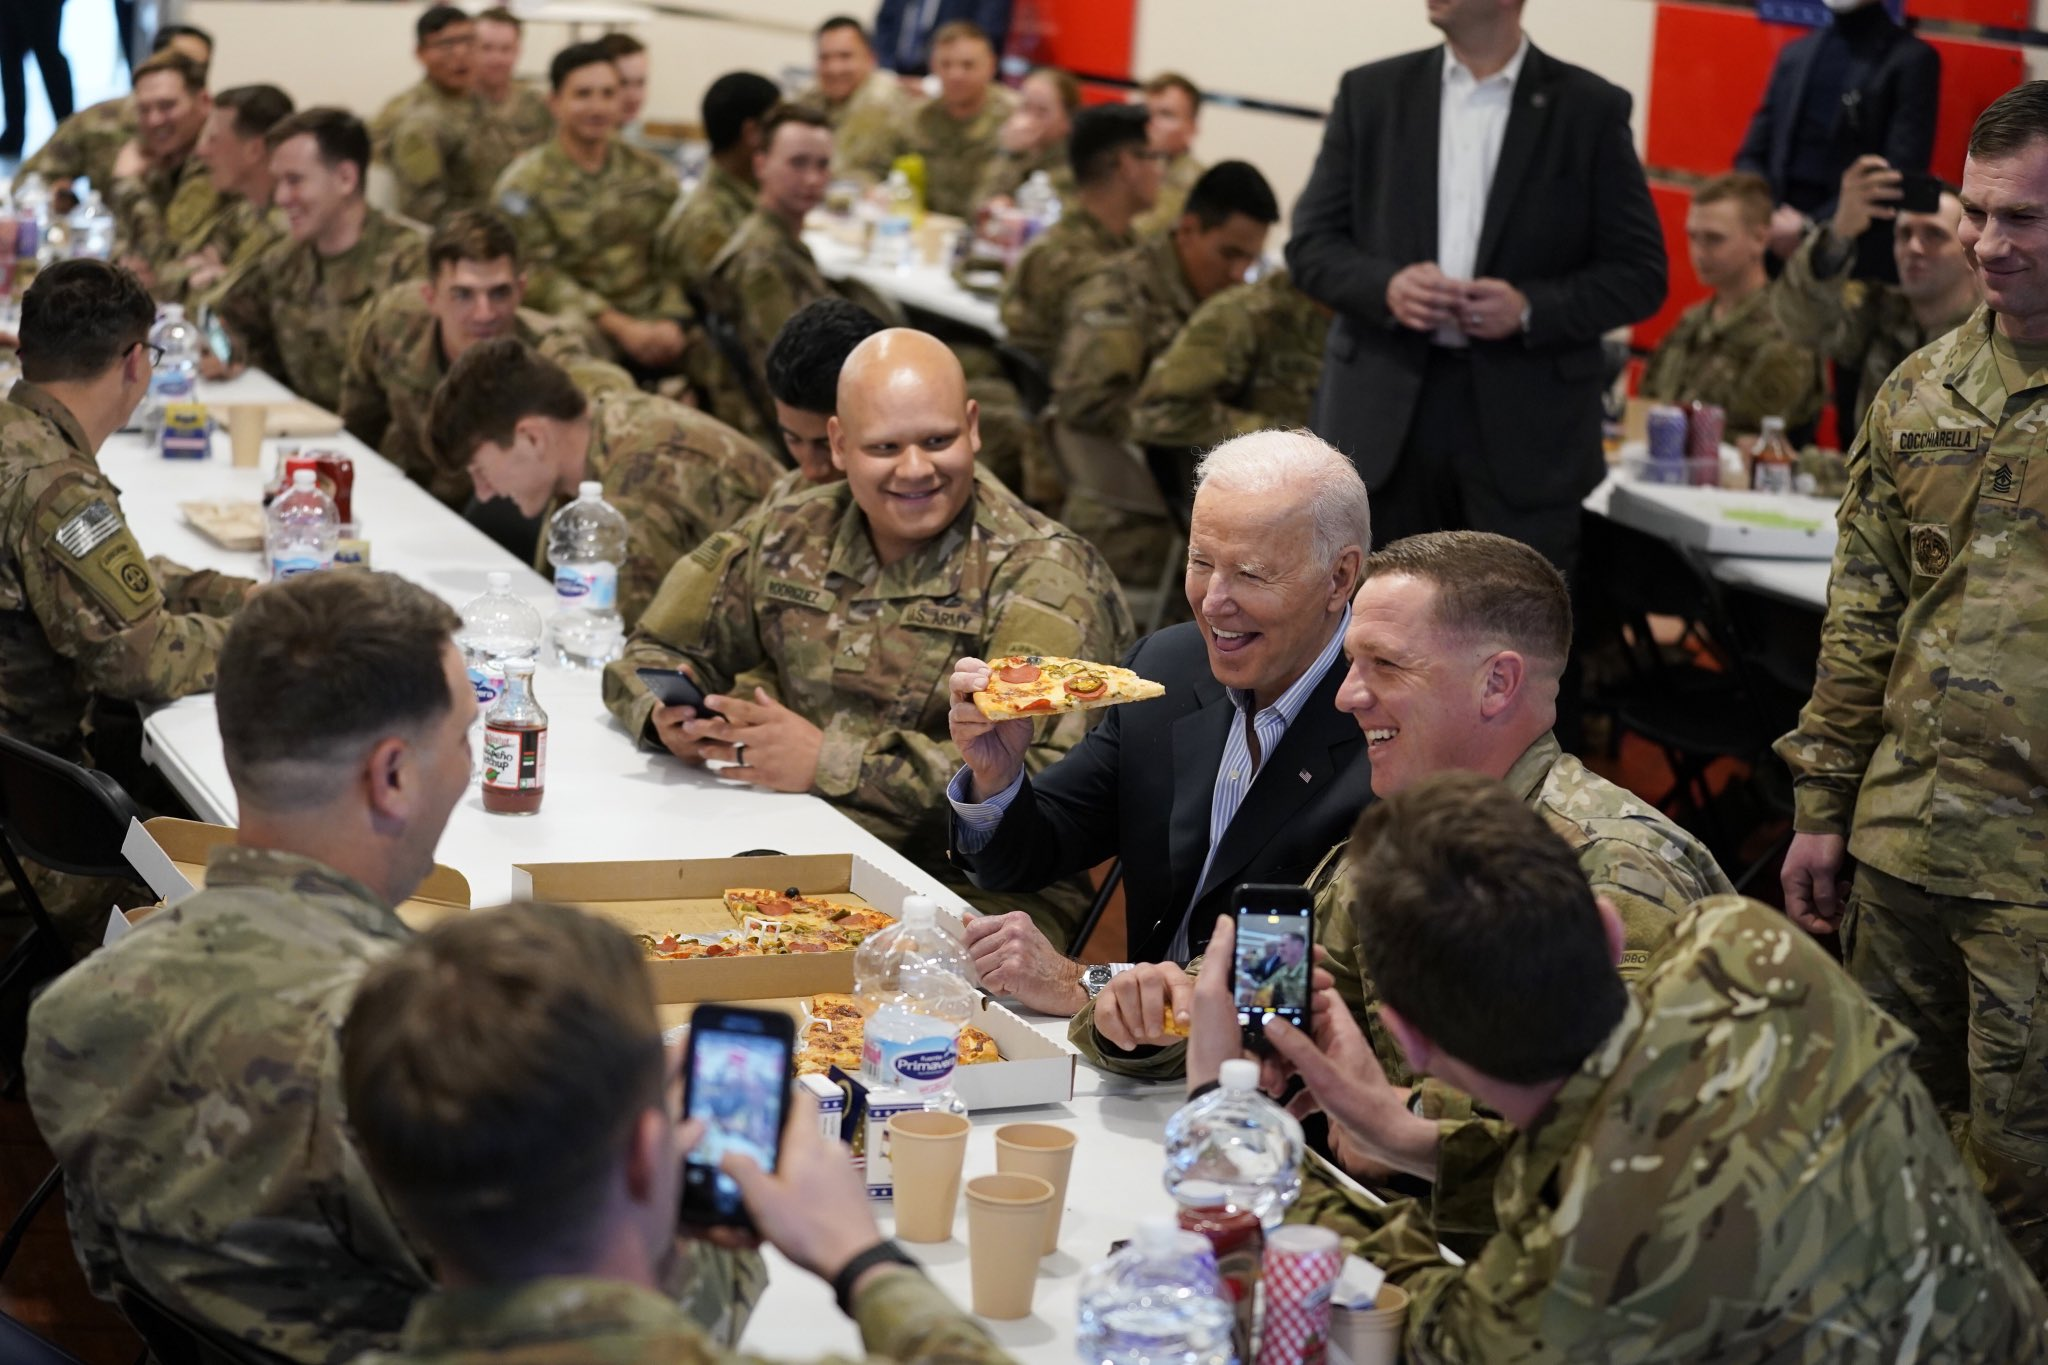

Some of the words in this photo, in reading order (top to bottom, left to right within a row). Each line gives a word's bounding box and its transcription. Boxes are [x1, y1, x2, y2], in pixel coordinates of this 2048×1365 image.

[1901, 431, 1971, 449] COCCHIARELLA
[769, 581, 820, 603] RODRIGUEZ
[932, 611, 973, 629] ARMY
[1620, 953, 1647, 964] IRBO
